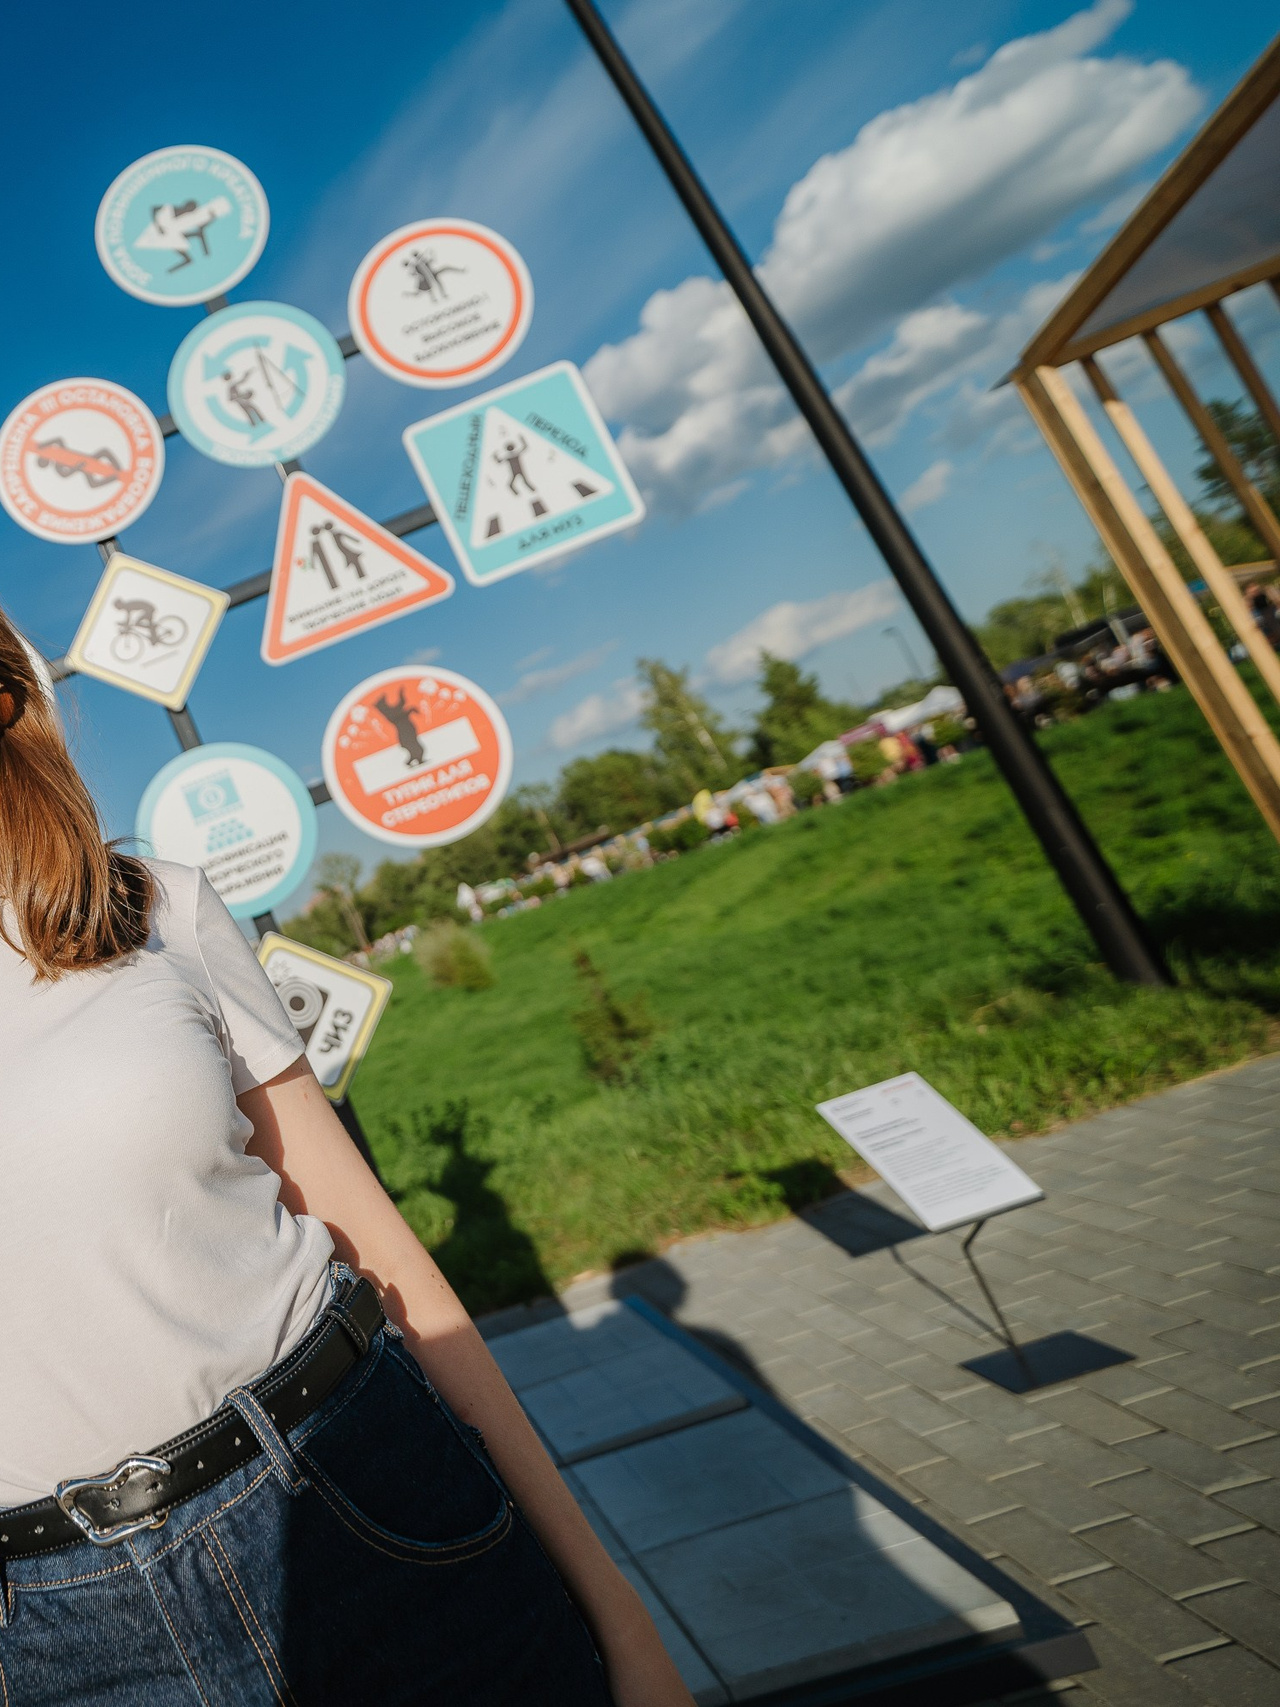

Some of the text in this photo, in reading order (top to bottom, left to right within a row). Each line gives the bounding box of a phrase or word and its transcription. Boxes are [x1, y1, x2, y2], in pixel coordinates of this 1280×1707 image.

[58, 387, 152, 450] ОСТАНОВКА
[525, 412, 588, 459] ПЕРЕХОД
[4, 411, 39, 515] ЗАПРЕЩЕНА
[456, 414, 482, 522] ПЕШЕХОДНЫЙ
[37, 456, 153, 533] ВООБРАЖЕНИЯ
[381, 772, 491, 828] СТЕРЕОТИПОВ
[382, 758, 474, 807] ТУПИК ДЛЯ
[320, 1008, 355, 1053] ЧИЗ
